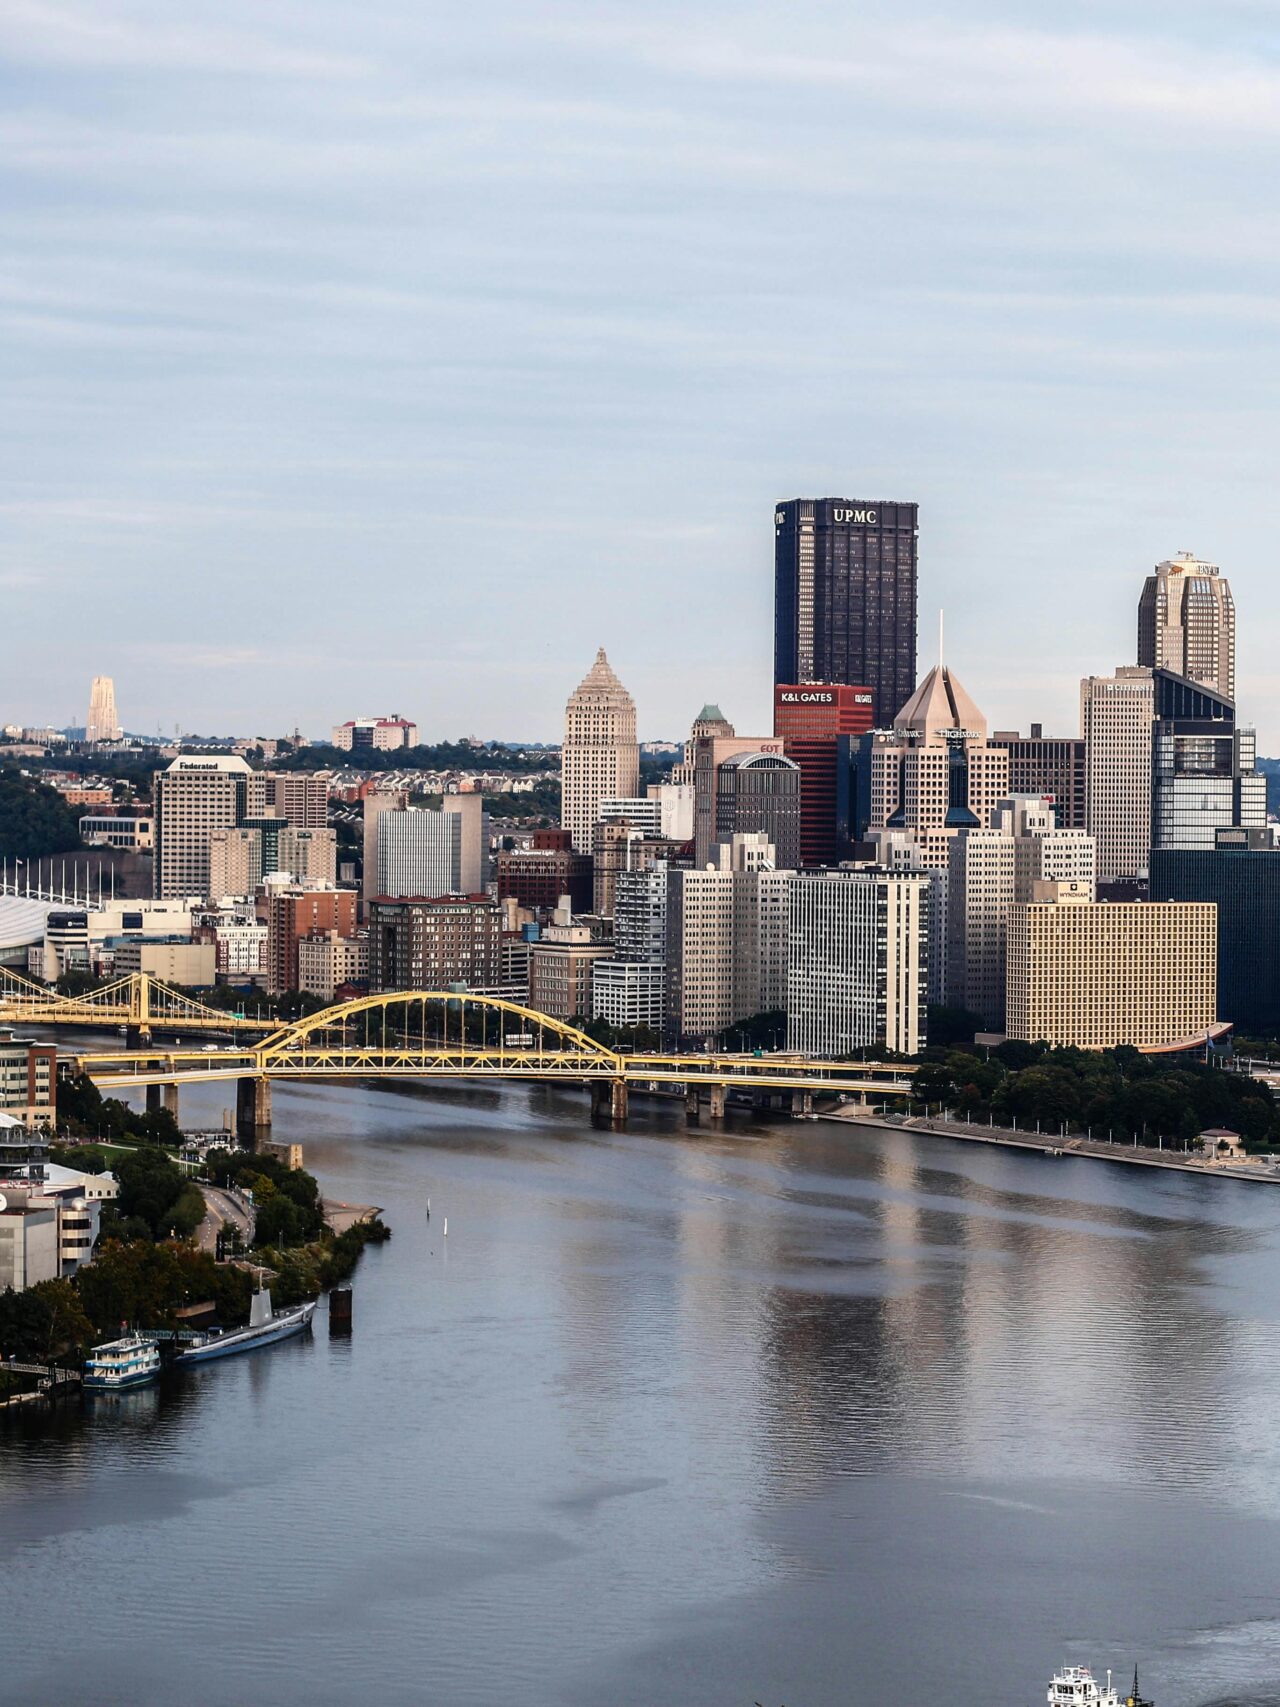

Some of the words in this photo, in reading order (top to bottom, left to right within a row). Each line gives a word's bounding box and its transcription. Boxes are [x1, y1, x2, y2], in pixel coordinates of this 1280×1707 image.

[833, 509, 877, 523] UPMC
[781, 693, 800, 702] K&L
[801, 693, 832, 702] GATES
[180, 762, 218, 770] Federated
